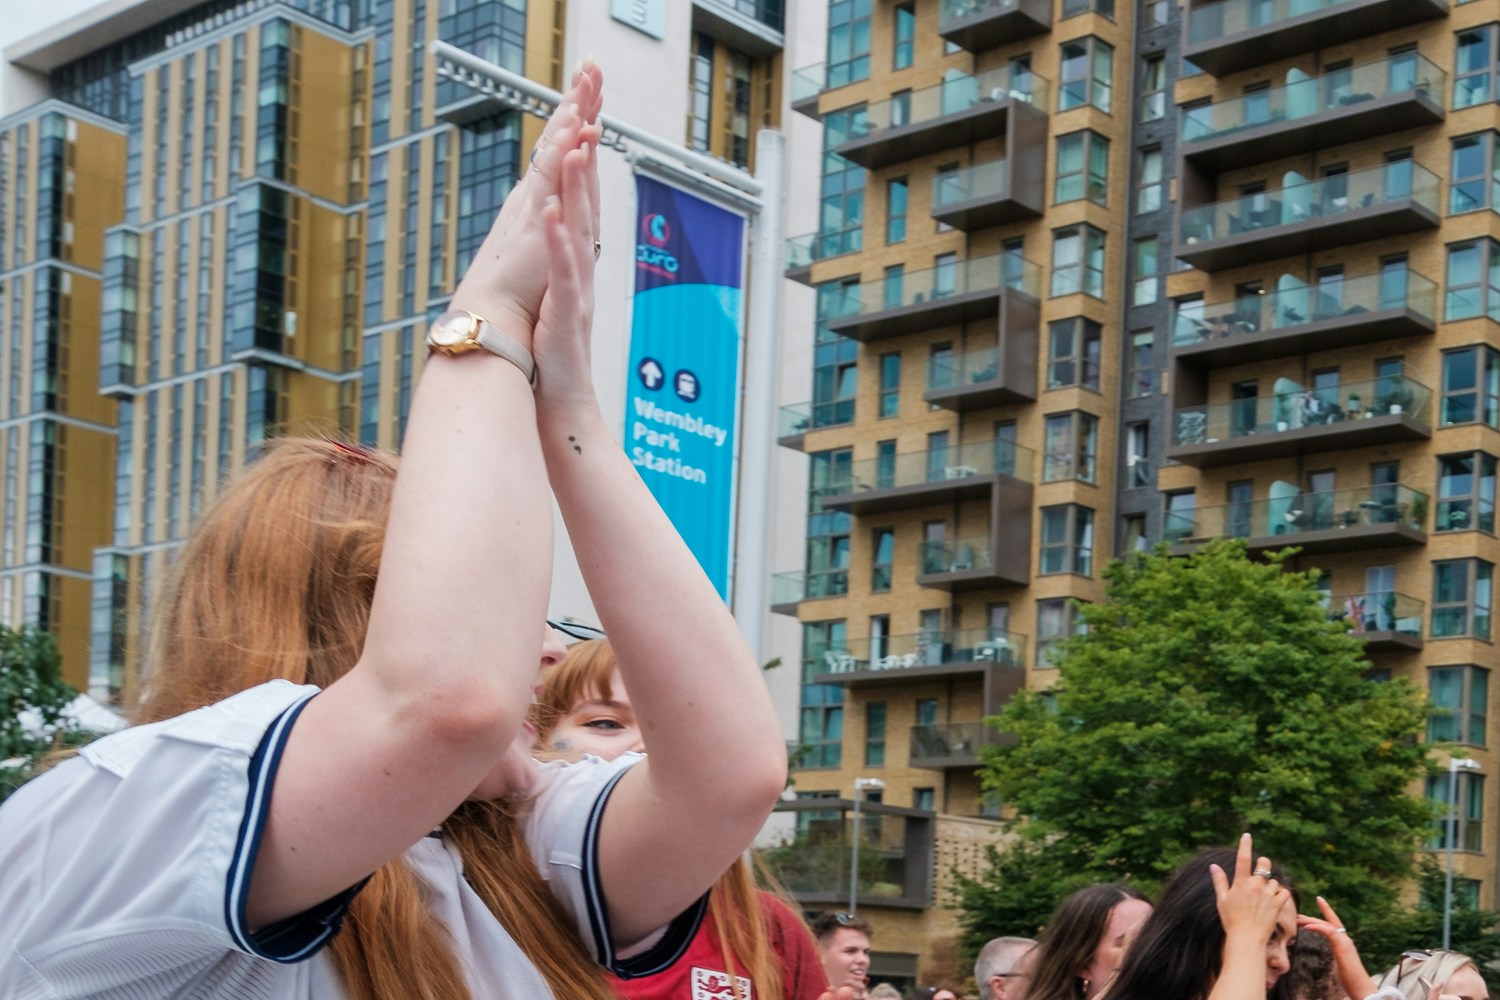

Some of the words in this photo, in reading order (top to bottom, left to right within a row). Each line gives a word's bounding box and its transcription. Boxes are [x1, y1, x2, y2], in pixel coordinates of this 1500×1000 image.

[633, 396, 728, 447] Wembley
[633, 421, 680, 452] Park
[631, 446, 707, 485] Station
